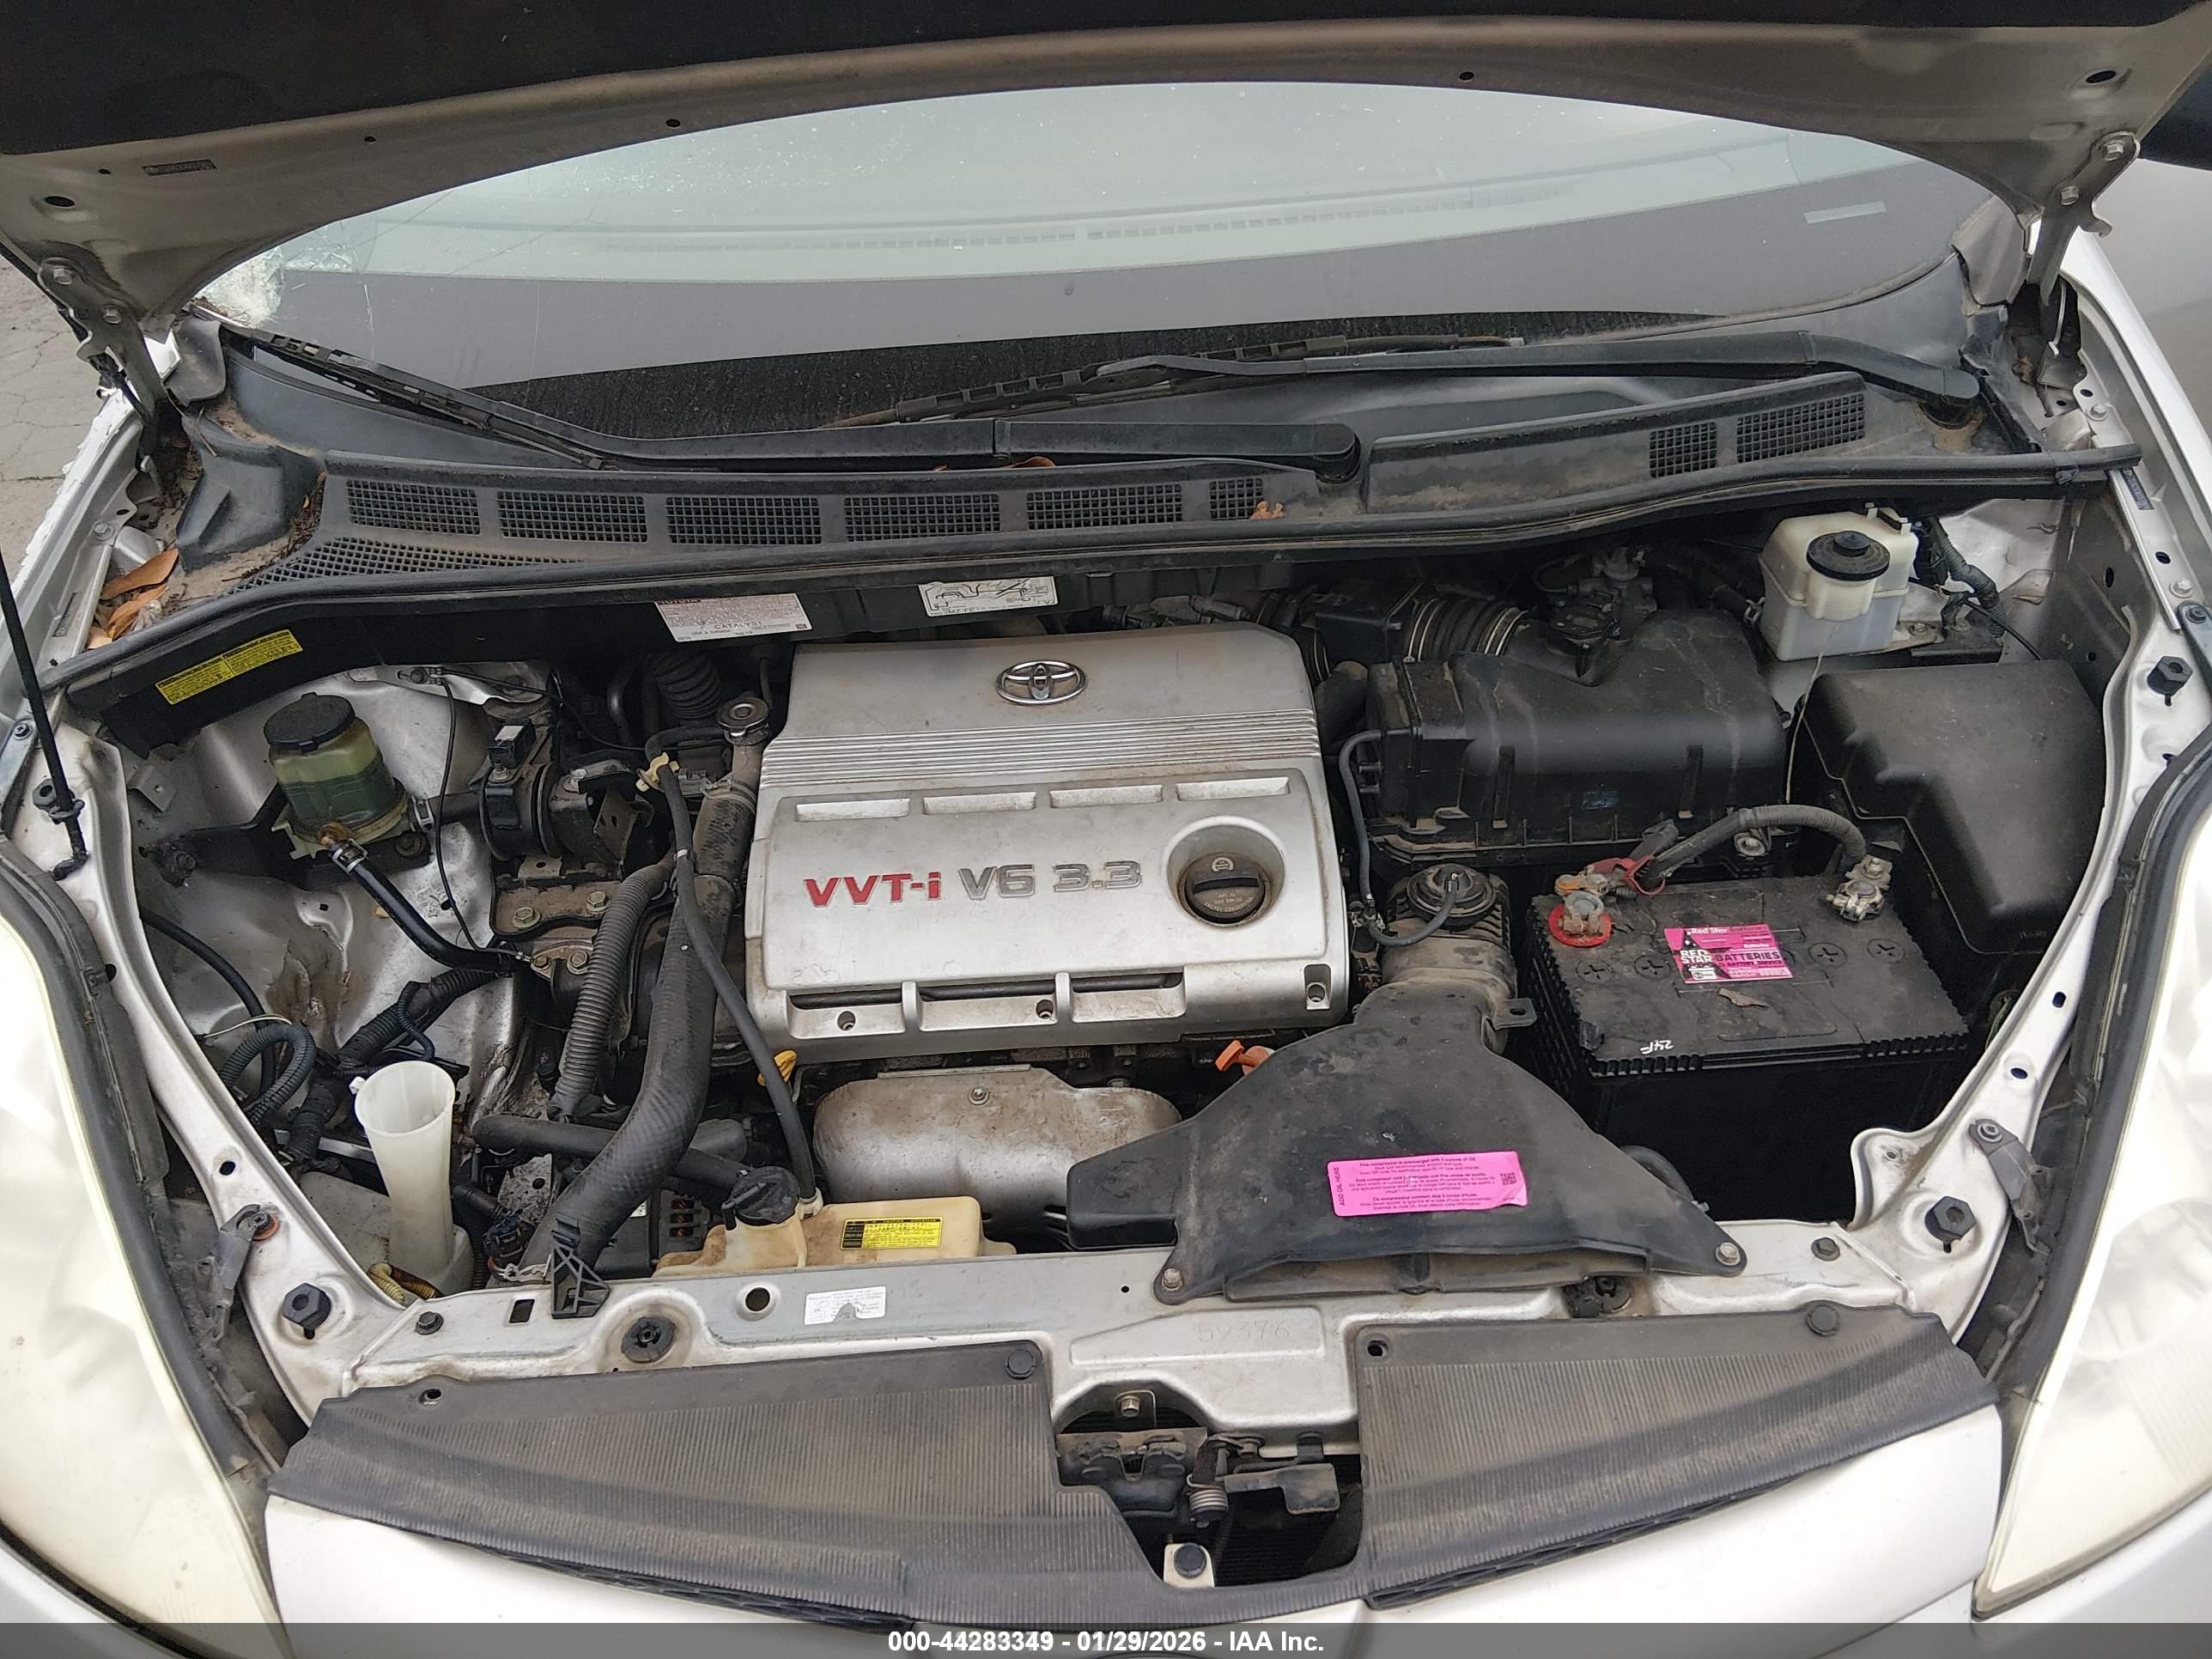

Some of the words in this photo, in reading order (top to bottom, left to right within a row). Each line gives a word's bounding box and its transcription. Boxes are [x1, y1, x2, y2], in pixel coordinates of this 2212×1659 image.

[804, 871, 942, 908] VVT-i
[958, 864, 1036, 901] V6
[1053, 860, 1142, 893] 3.3
[1716, 951, 1780, 962] BATTERIES
[1639, 1040, 1674, 1054] 24F
